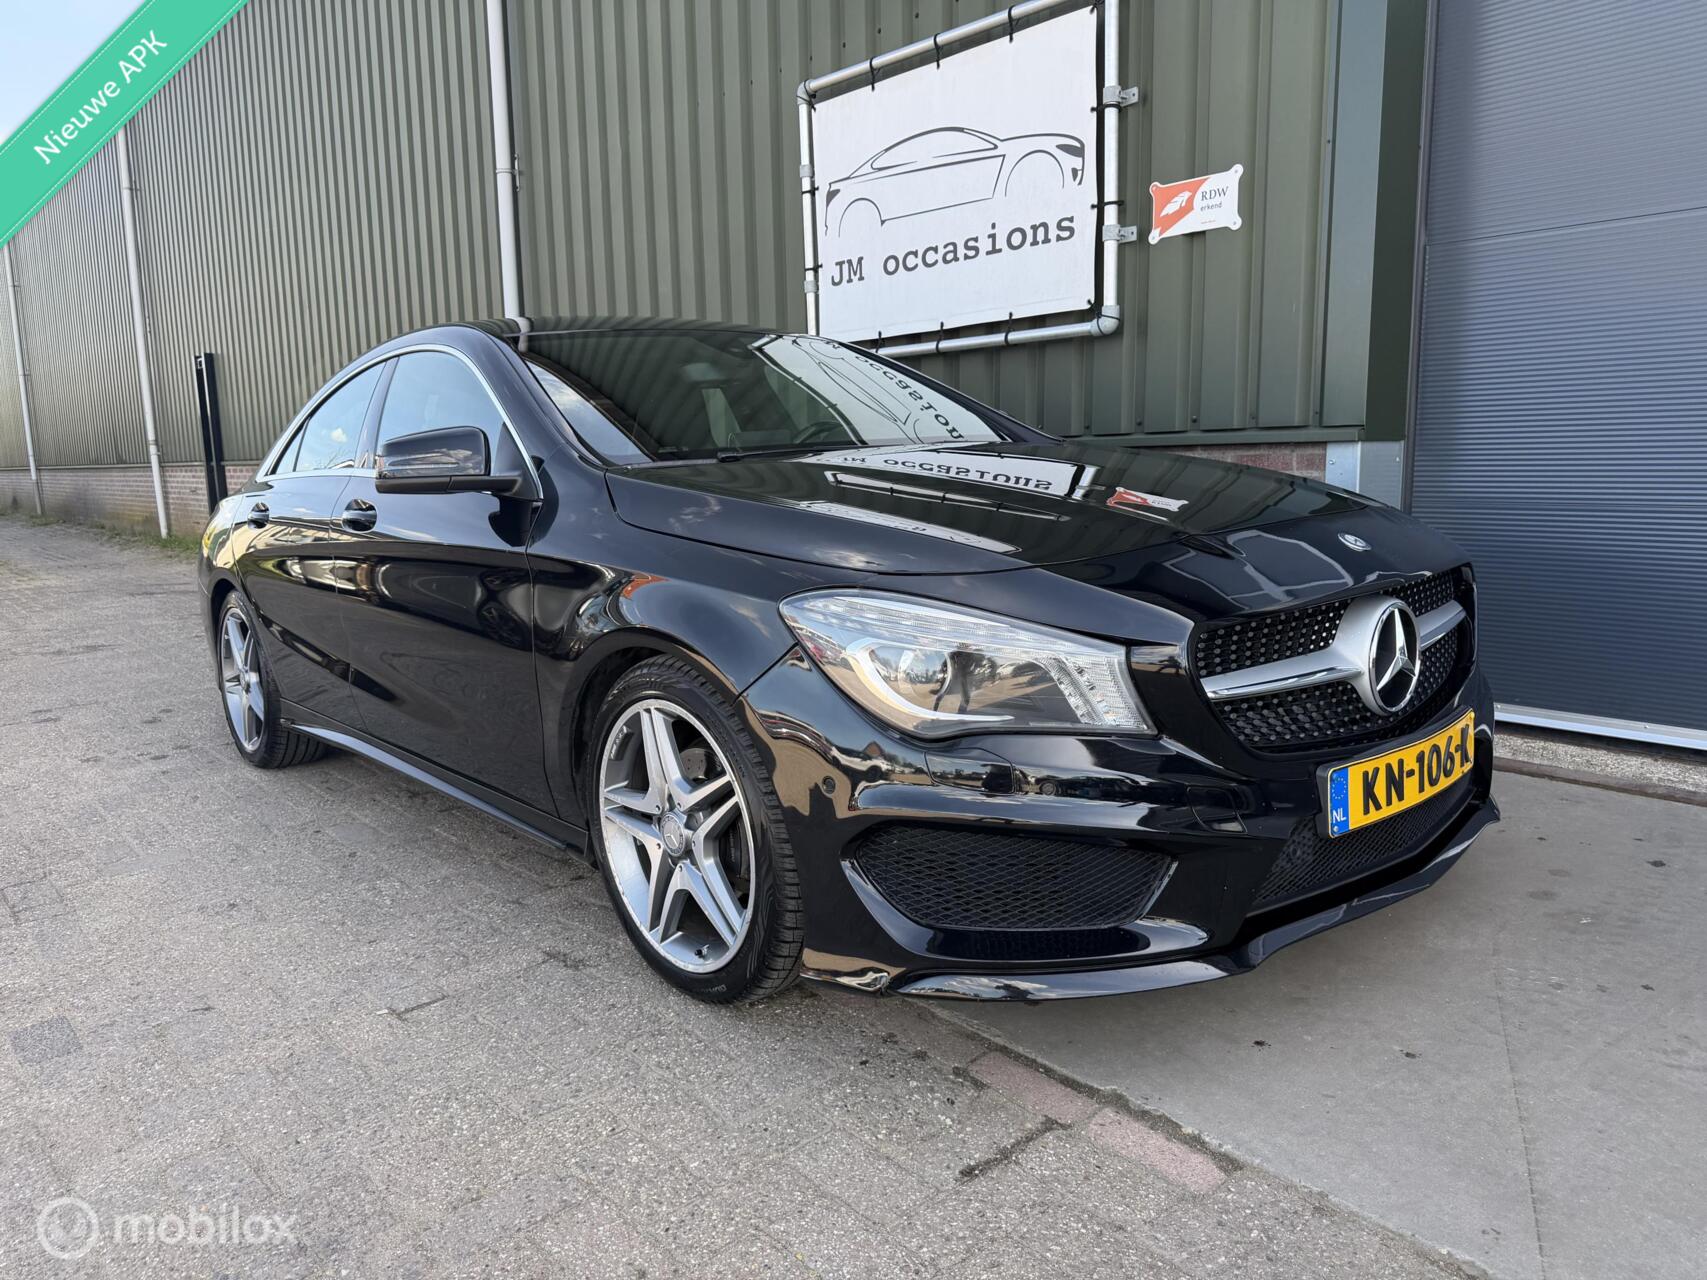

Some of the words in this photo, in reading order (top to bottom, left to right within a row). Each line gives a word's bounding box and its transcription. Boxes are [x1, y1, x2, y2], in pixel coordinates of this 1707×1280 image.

[1201, 186, 1229, 201] RDW
[1200, 201, 1223, 212] erkend
[831, 256, 865, 287] JM
[883, 215, 1076, 277] occasions
[1362, 724, 1473, 816] KN-106-K
[1332, 808, 1347, 824] NL
